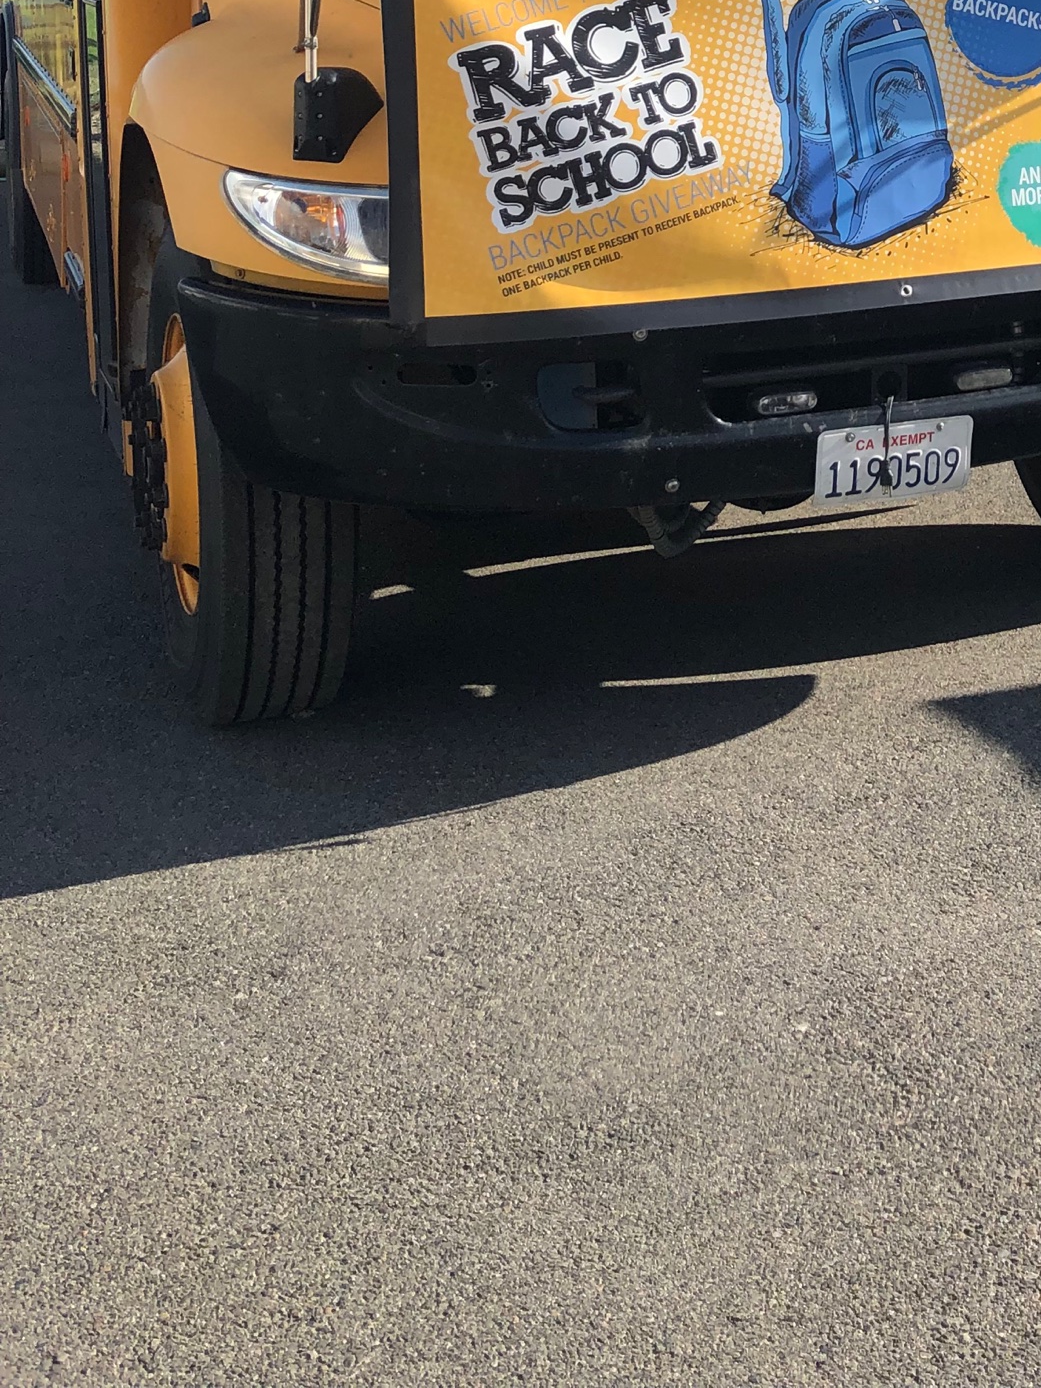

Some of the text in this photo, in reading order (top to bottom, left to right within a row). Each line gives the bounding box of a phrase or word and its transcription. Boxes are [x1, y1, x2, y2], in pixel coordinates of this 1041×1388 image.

[476, 72, 698, 173] BACK TO
[488, 160, 752, 271] BACKPACK GIVEAWAY
[493, 121, 719, 228] SCHOOL
[497, 267, 527, 285] NOTE:
[527, 258, 555, 274] CHILD
[556, 249, 583, 265] MUST
[583, 244, 598, 256] BE
[598, 230, 640, 252] PRESENT
[641, 225, 655, 238] TO
[654, 211, 695, 233] RECEIVE
[501, 283, 523, 298] ONE
[522, 266, 573, 291] BACKPACK
[572, 260, 592, 274] PER
[856, 438, 875, 451] CA
